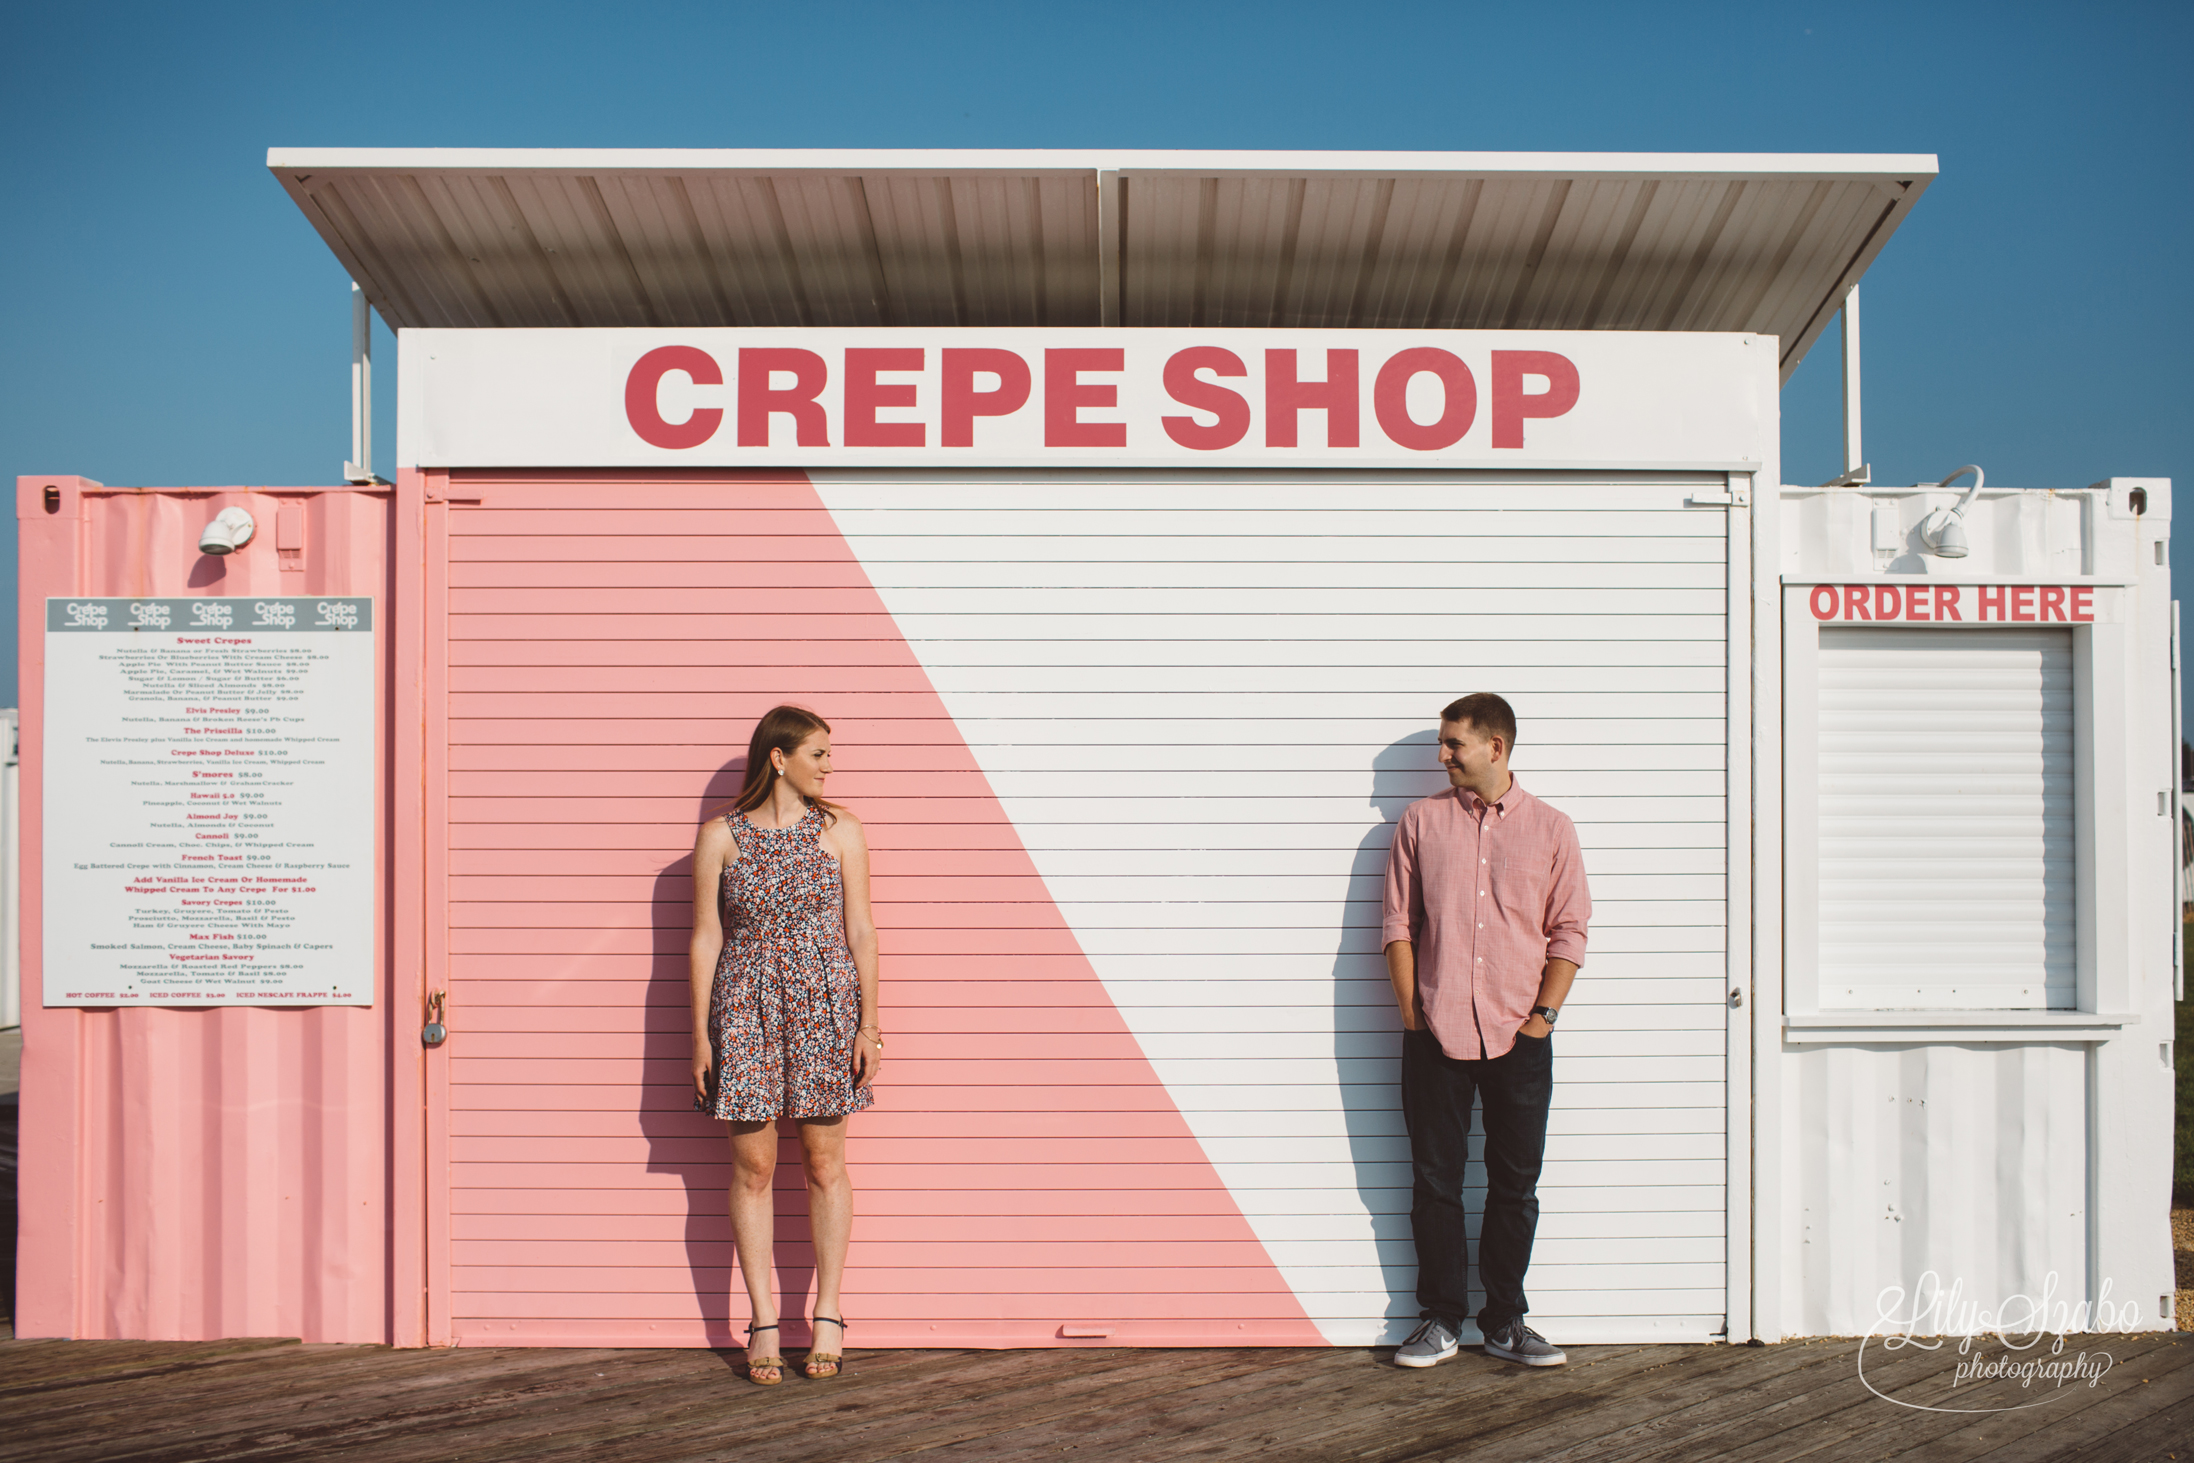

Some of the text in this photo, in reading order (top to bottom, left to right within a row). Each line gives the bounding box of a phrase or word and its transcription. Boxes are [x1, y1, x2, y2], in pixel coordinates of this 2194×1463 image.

[624, 345, 1580, 451] CREPE SHOP
[1809, 584, 2095, 622] ORDER HERE
[64, 614, 108, 630] Shop
[128, 614, 171, 630] Shop
[190, 614, 233, 630] Shop
[252, 614, 296, 630] Shop
[314, 614, 358, 630] Shop
[177, 636, 252, 646] Sweet Crepes
[124, 886, 167, 894] Whipped
[239, 886, 267, 894] Crepe
[181, 898, 211, 906] Savory
[213, 898, 243, 906] Crepes
[169, 954, 254, 962] Vegetarian Savory
